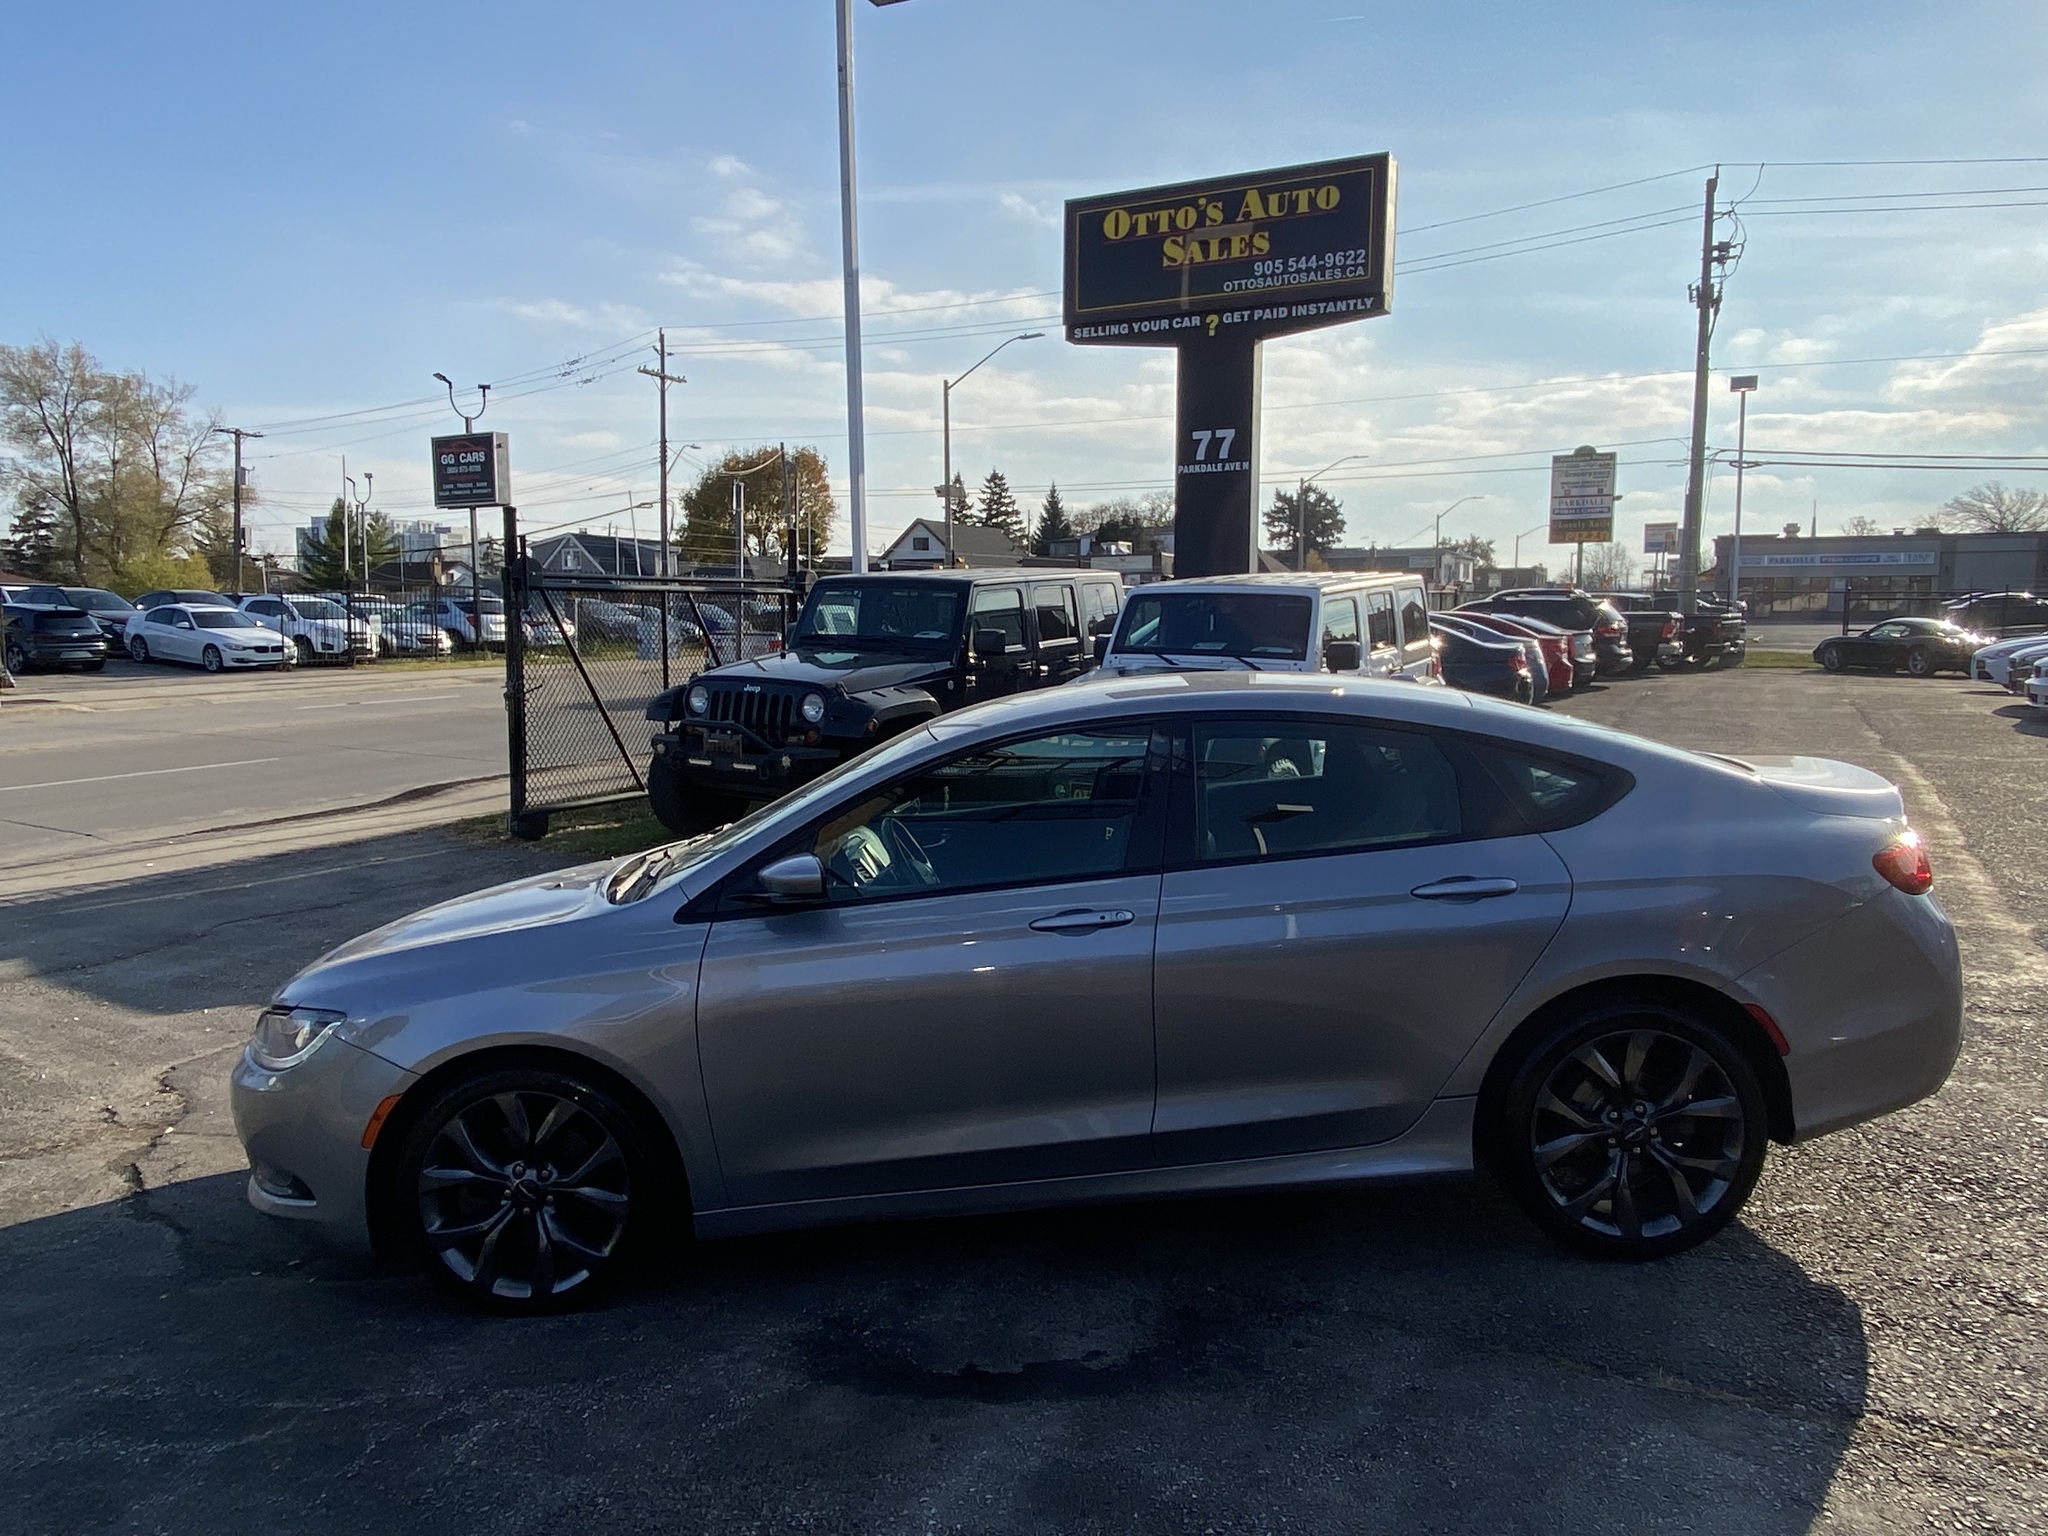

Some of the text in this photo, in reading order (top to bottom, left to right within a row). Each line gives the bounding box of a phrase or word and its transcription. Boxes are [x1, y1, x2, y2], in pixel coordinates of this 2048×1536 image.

[1103, 185, 1341, 240] OTTO'S AUTO
[1163, 231, 1271, 267] SALES
[1253, 249, 1366, 276] 905 544-9622
[1223, 266, 1365, 292] OTTOSAUTOSALES.CA
[1074, 323, 1129, 338] SELLING
[1132, 319, 1170, 333] YOUR
[1172, 316, 1201, 328] CAR
[1223, 311, 1251, 323] GET
[1253, 306, 1288, 320] PAID
[1292, 297, 1374, 317] INSTANTLY
[459, 451, 486, 463] CARS
[1192, 428, 1236, 461] 77
[1178, 461, 1250, 474] PARKDALE AVE N
[1558, 498, 1604, 507] PARKDALE
[1769, 556, 1817, 564] PARKDALE
[743, 683, 761, 693] Jeep
